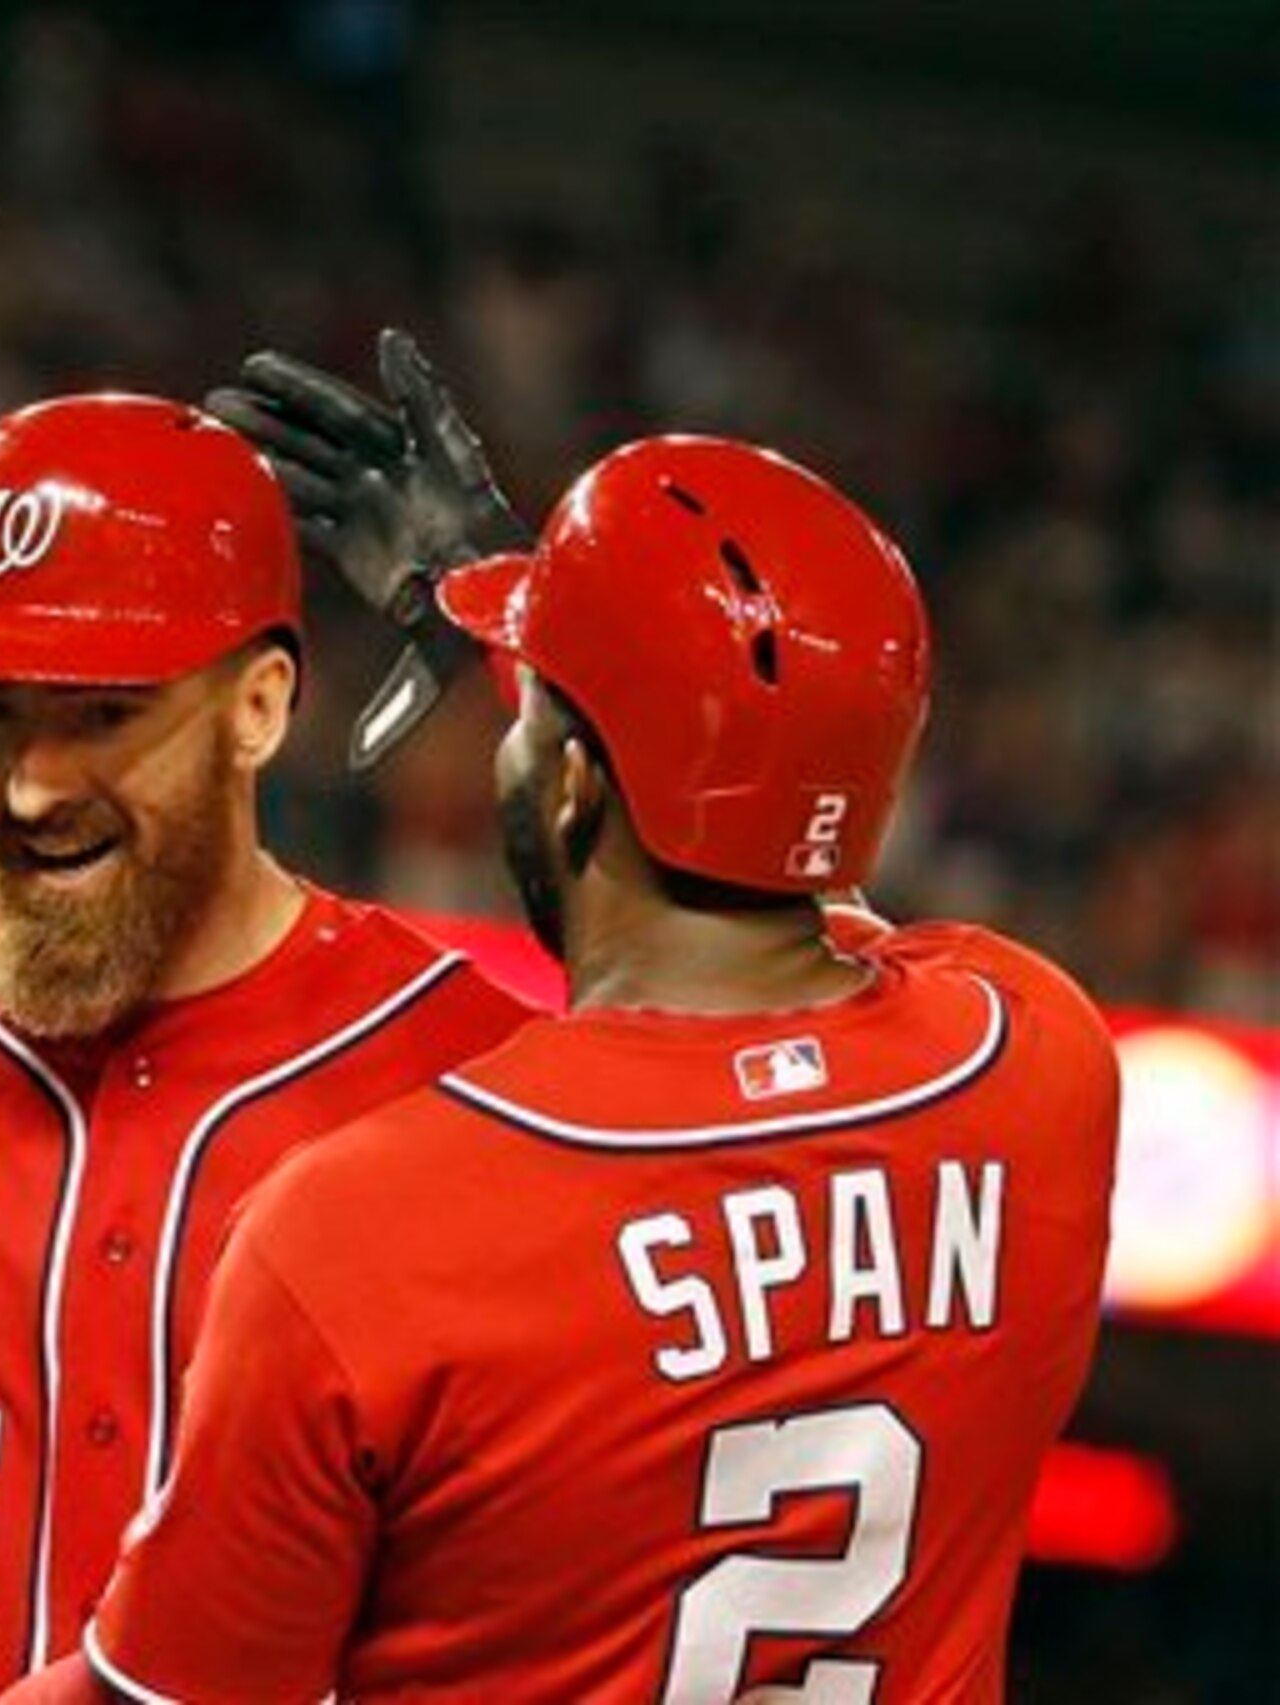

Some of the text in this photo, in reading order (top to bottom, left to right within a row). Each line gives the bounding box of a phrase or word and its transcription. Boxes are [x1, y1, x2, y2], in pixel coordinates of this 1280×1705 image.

[805, 793, 847, 842] 2
[616, 1159, 1005, 1381] SPAN
[661, 1403, 922, 1705] 2
